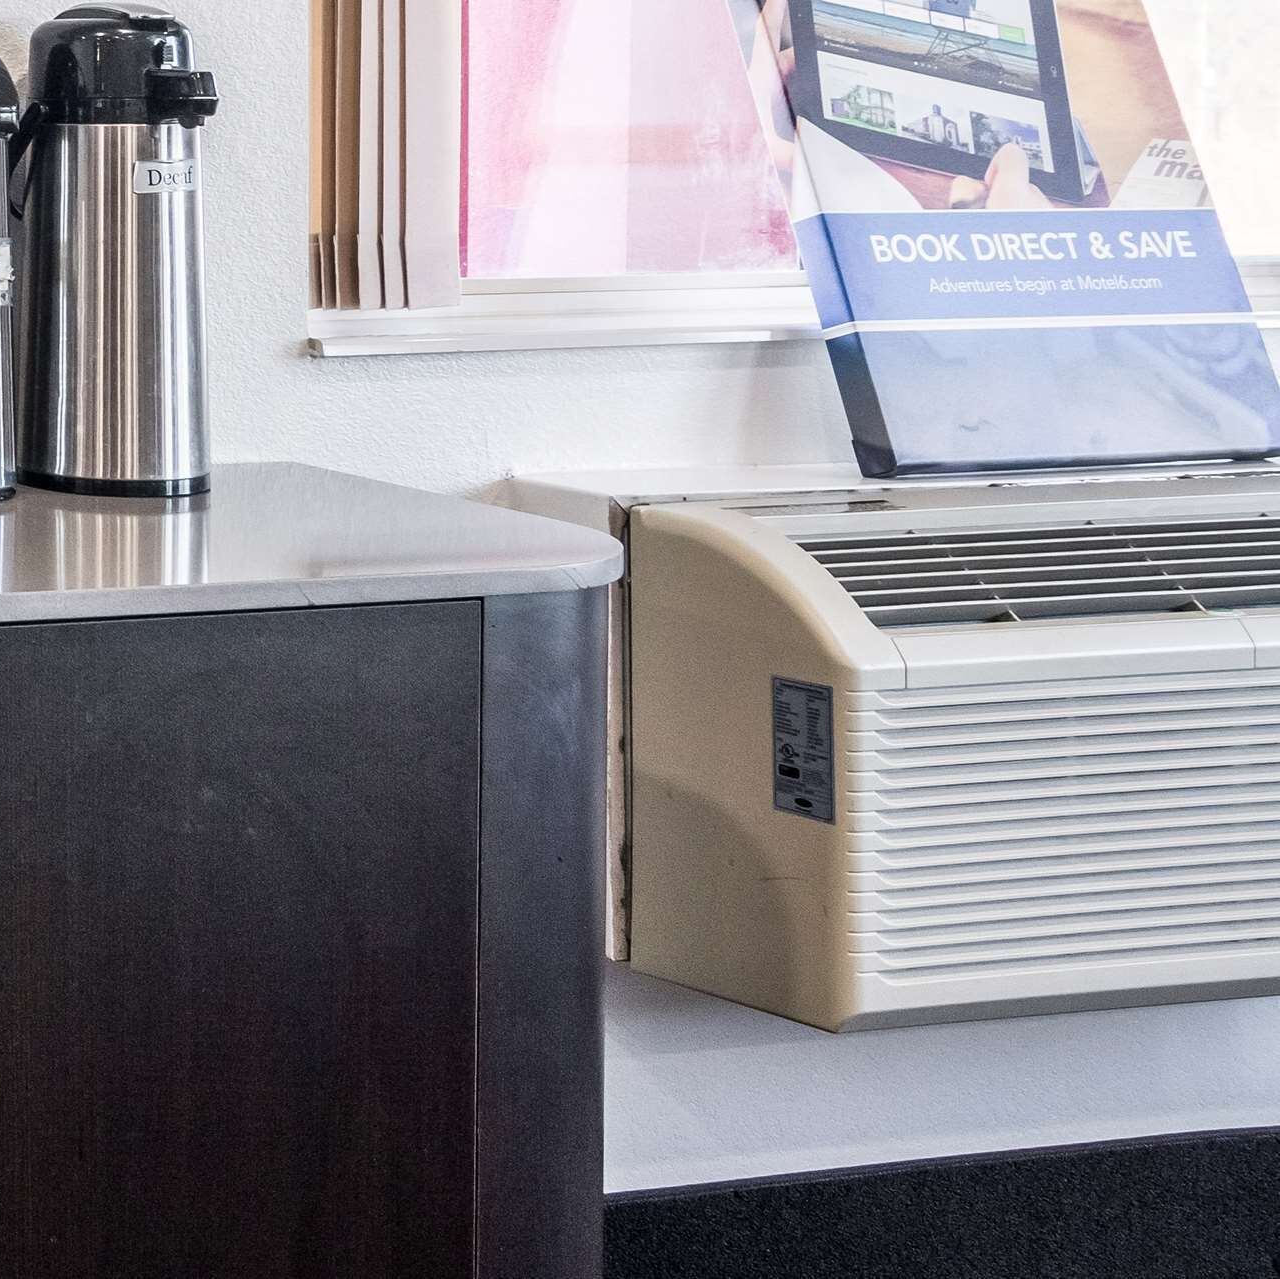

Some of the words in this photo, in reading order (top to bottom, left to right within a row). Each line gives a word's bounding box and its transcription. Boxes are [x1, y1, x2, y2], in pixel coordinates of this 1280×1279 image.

[1146, 139, 1186, 160] the
[869, 233, 968, 264] BOOK
[969, 231, 1079, 262] DIRECT
[1088, 231, 1115, 260] &
[1118, 229, 1198, 259] SAVE
[928, 276, 1013, 294] Adventures
[1014, 275, 1057, 296] begin
[1060, 277, 1076, 292] at
[1077, 274, 1163, 292] Motel6.com
